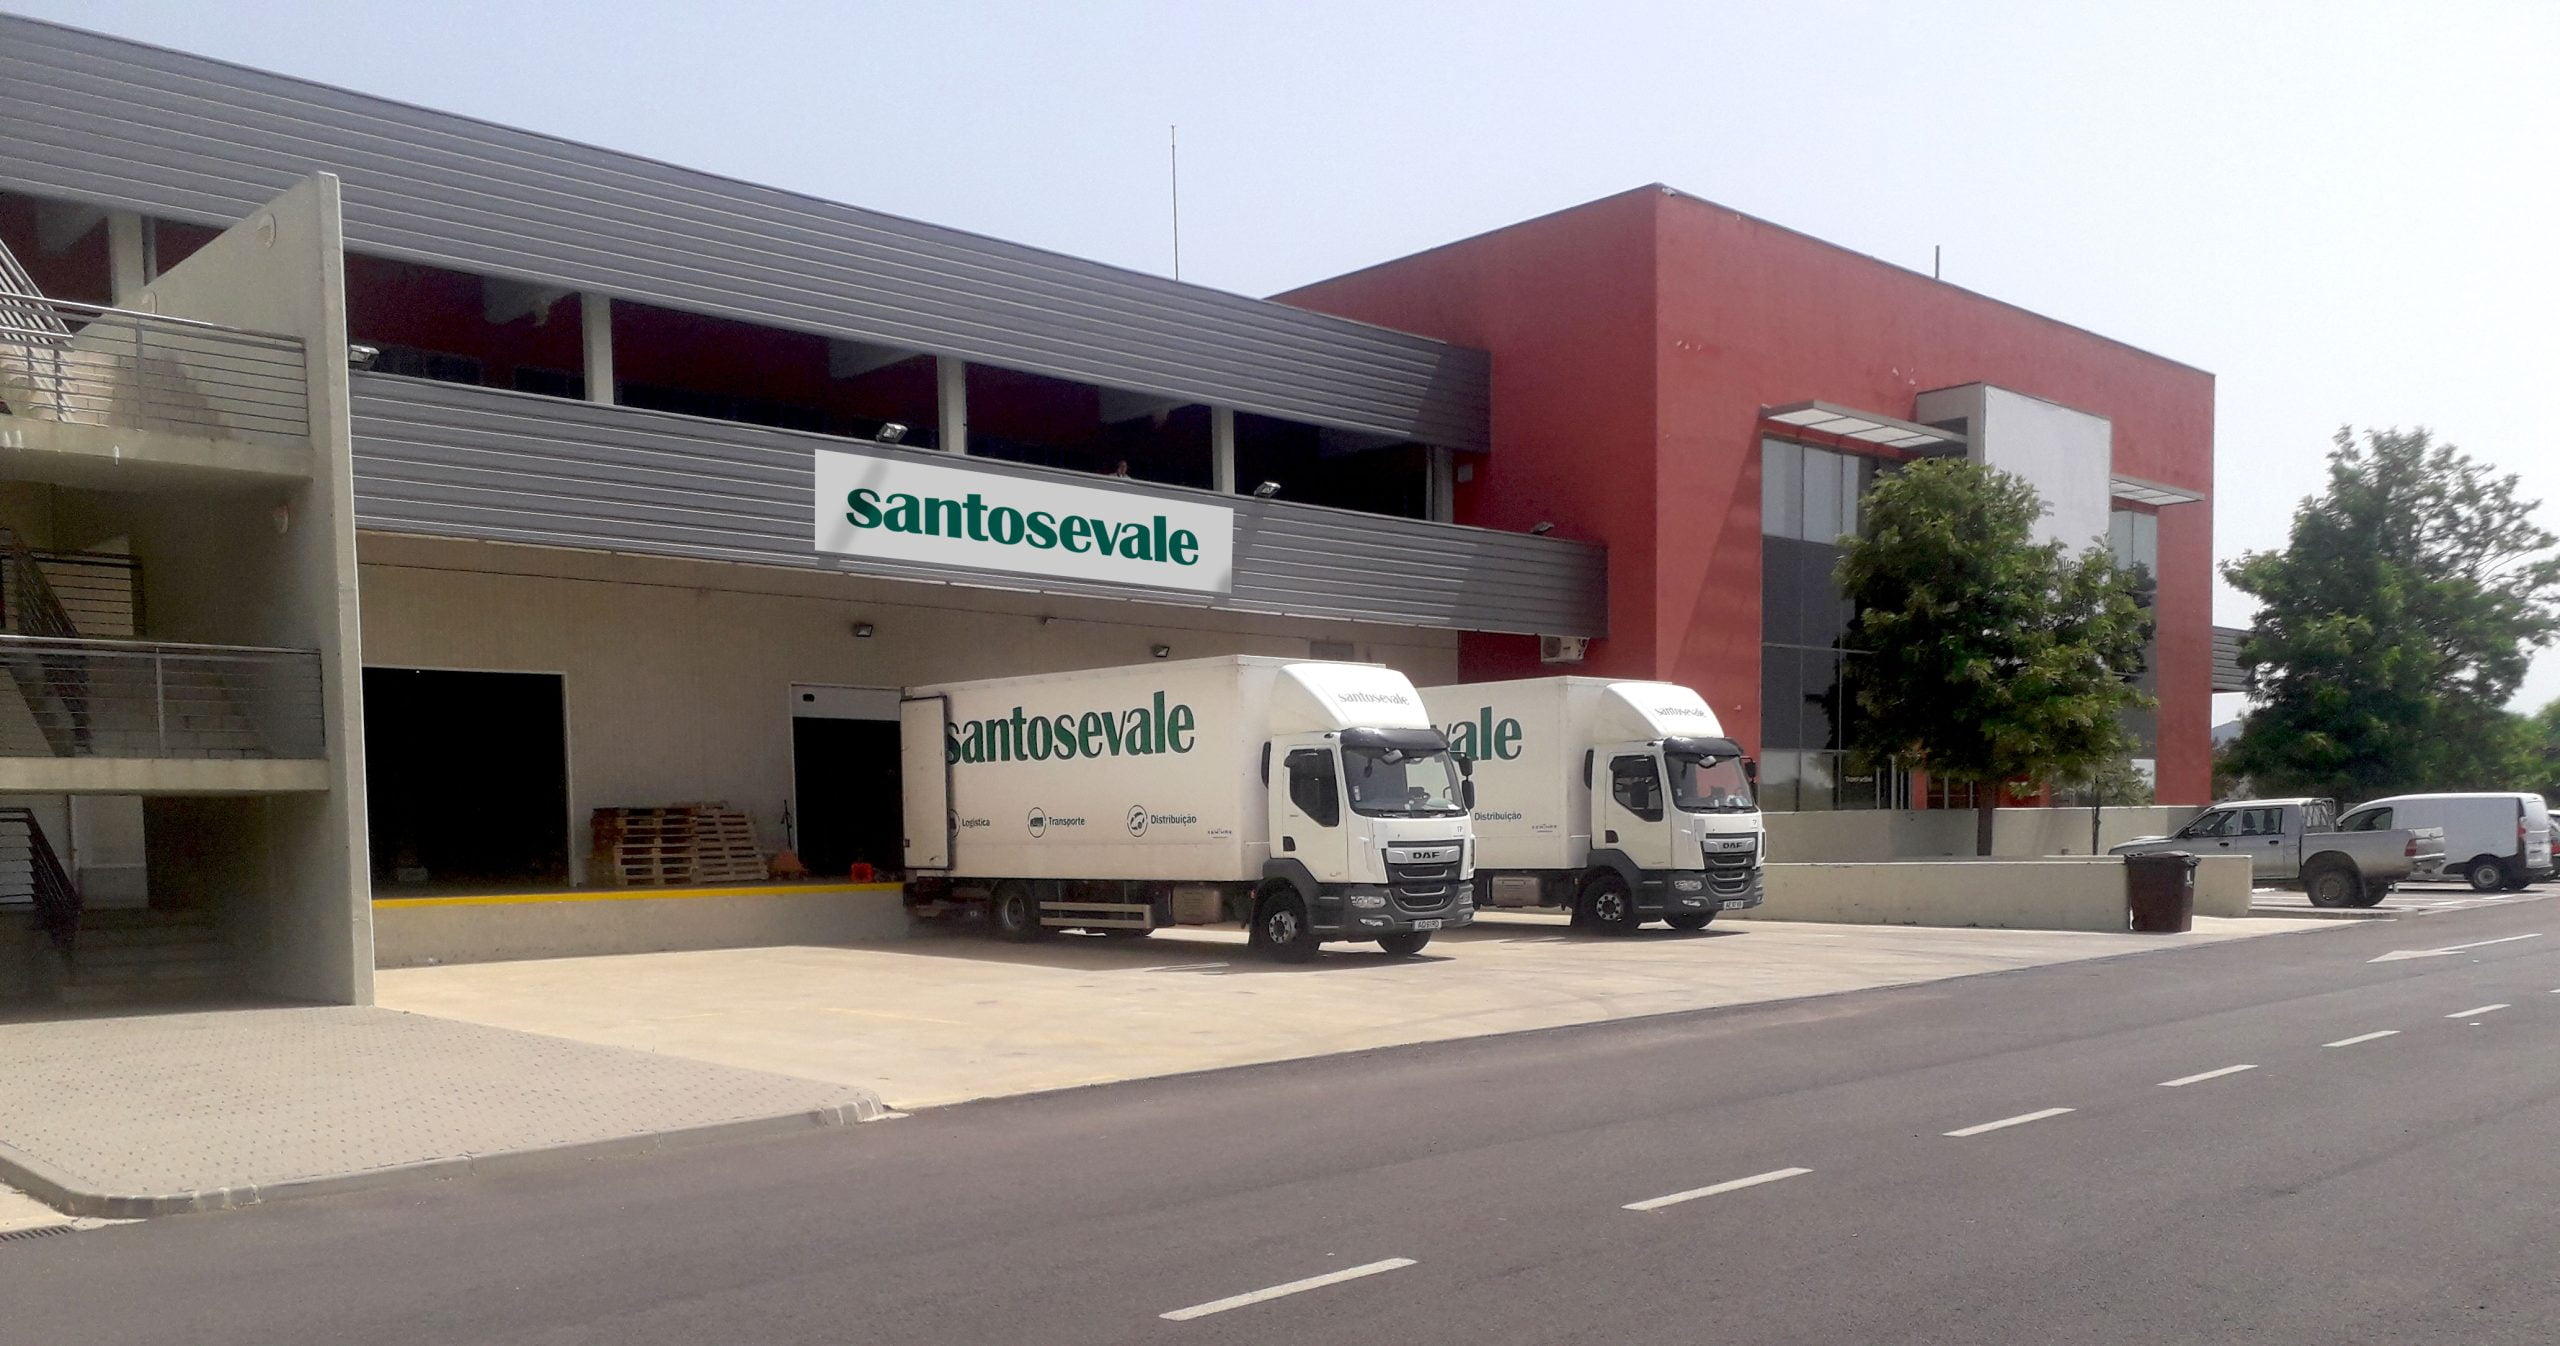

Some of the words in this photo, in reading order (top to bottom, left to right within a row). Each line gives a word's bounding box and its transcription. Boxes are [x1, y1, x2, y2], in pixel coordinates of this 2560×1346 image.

[845, 488, 1200, 566] santosevale
[1337, 691, 1410, 706] santosevale
[1048, 816, 1086, 828] Transporte
[1150, 812, 1197, 826] Distribuição
[1474, 811, 1522, 822] Distribuição
[1412, 851, 1441, 860] DAF
